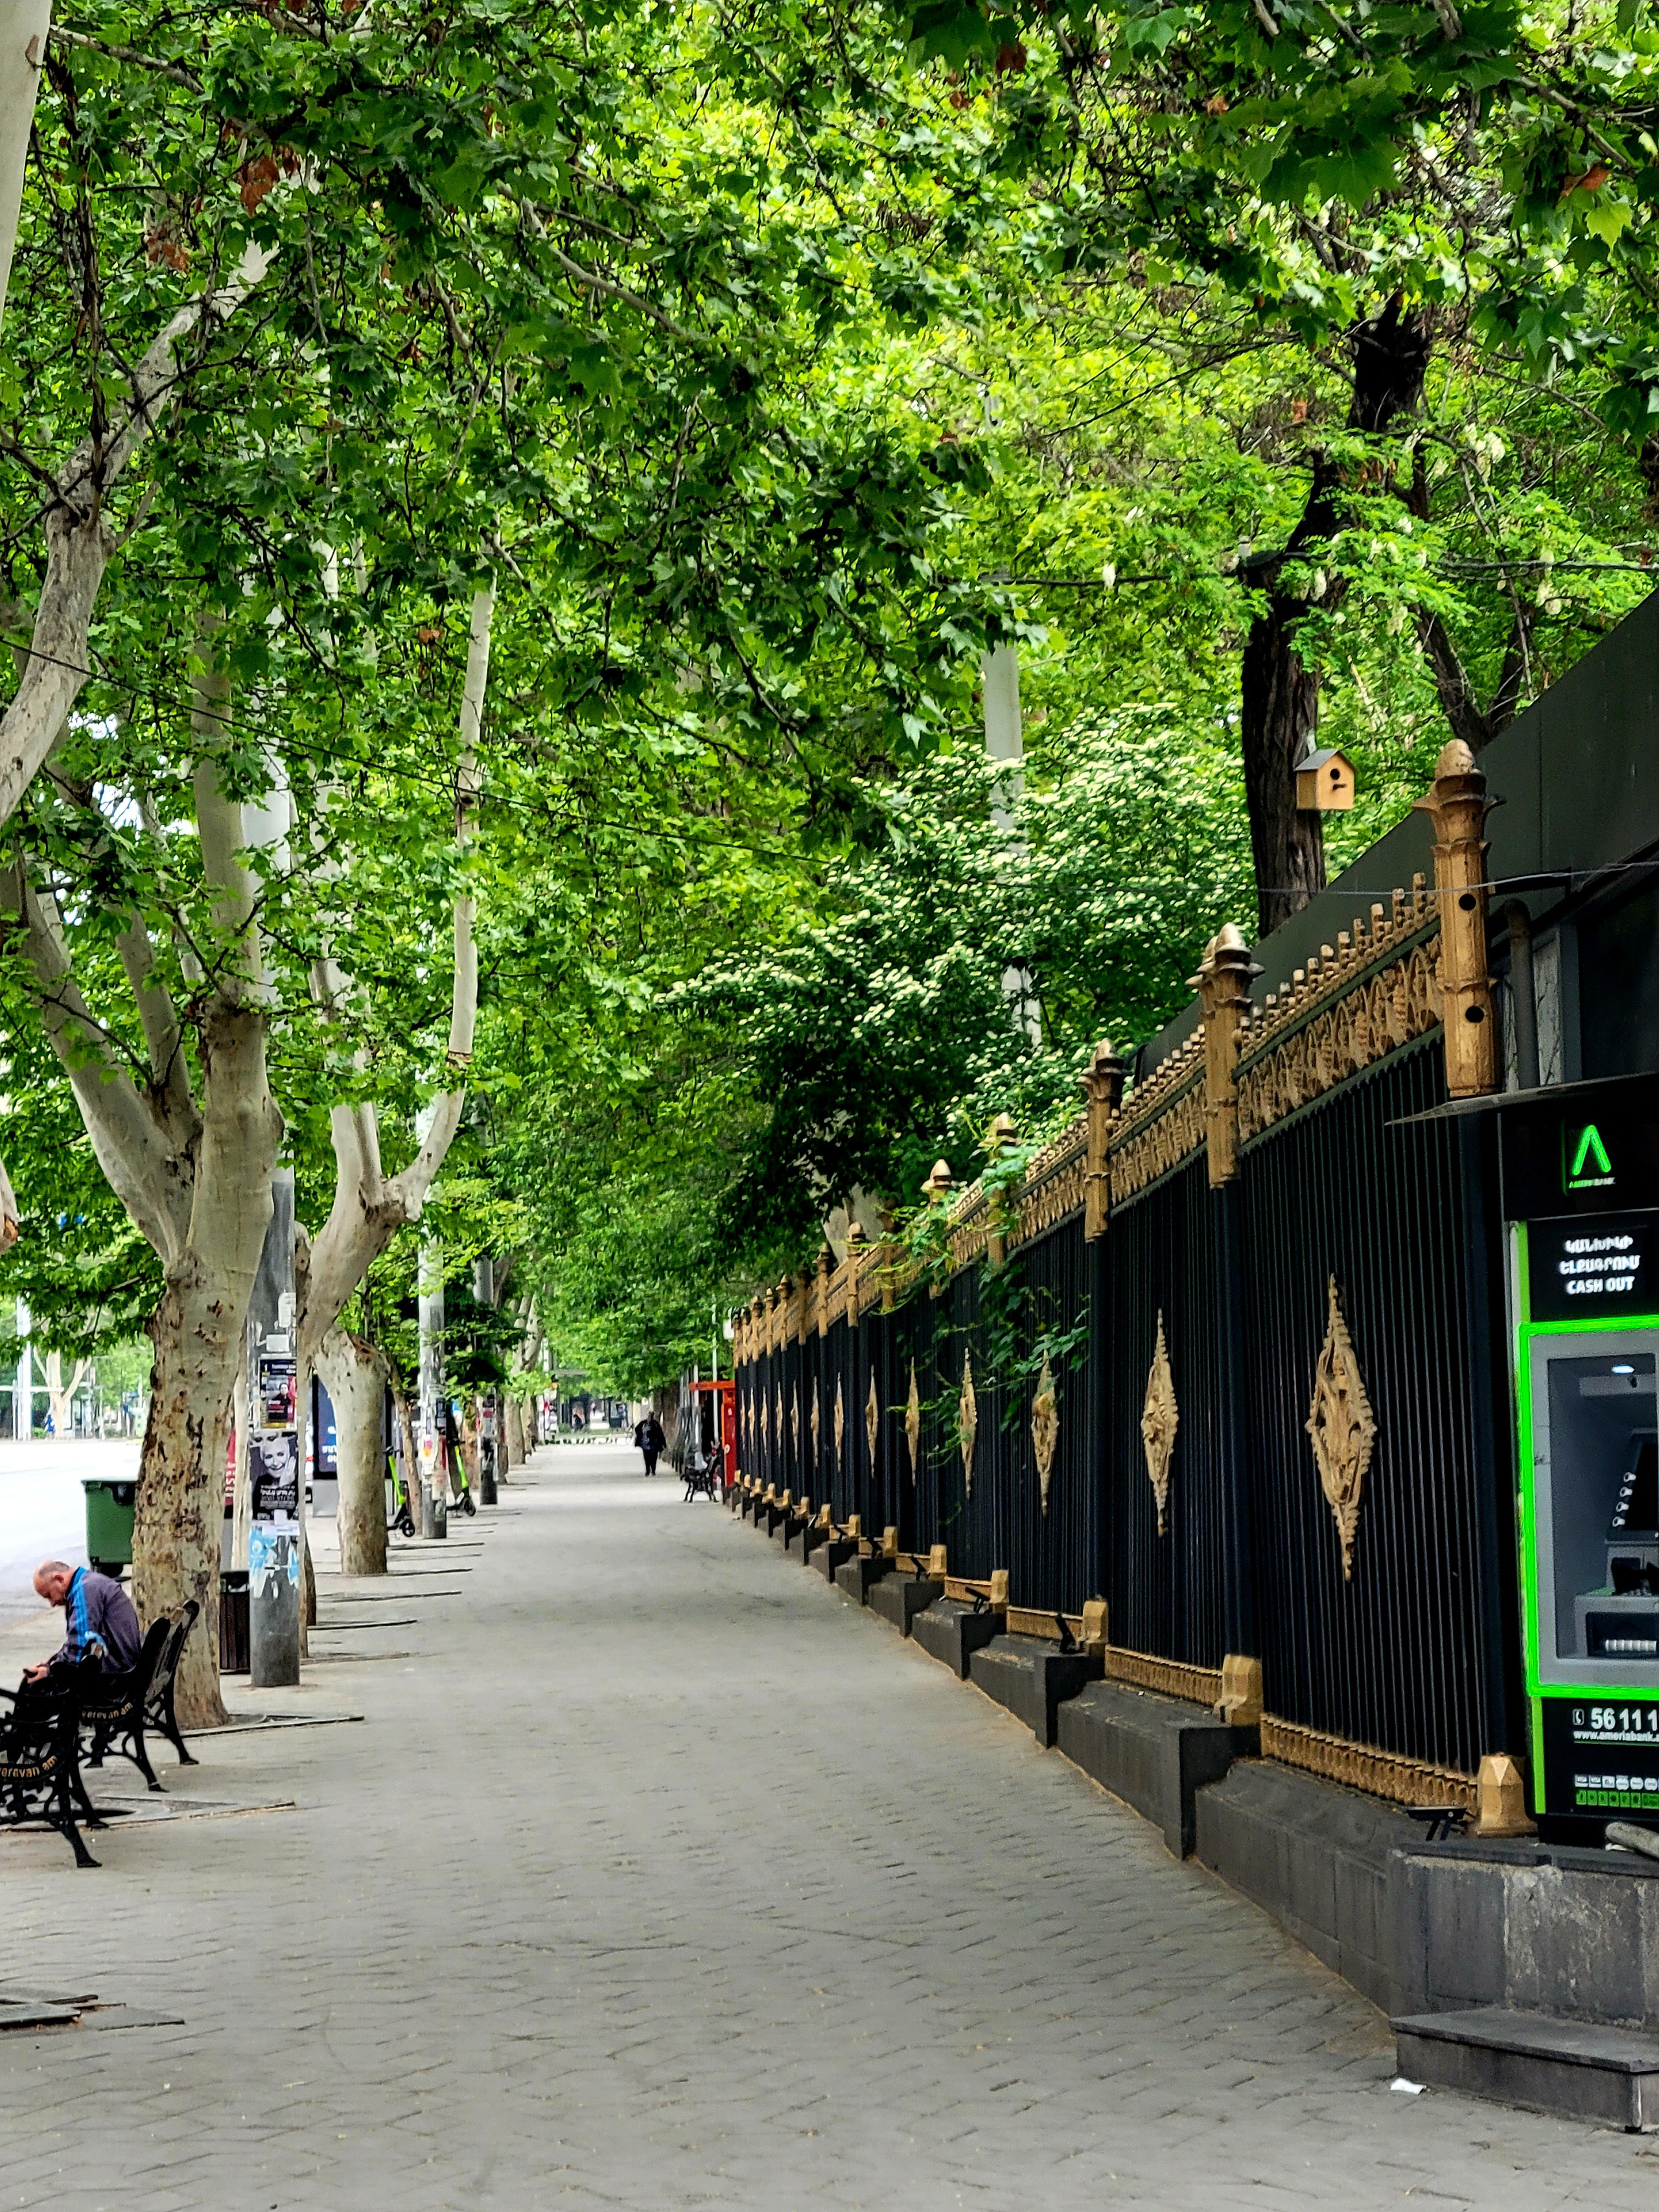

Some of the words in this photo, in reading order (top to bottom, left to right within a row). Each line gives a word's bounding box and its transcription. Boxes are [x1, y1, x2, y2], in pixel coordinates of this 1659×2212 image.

[1566, 1279, 1603, 1296] CASH
[1606, 1276, 1635, 1292] OUT
[1591, 1707, 1616, 1730] 56
[1619, 1708, 1642, 1730] 11
[1647, 1709, 1659, 1731] 1
[0, 1767, 40, 1777] erevan
